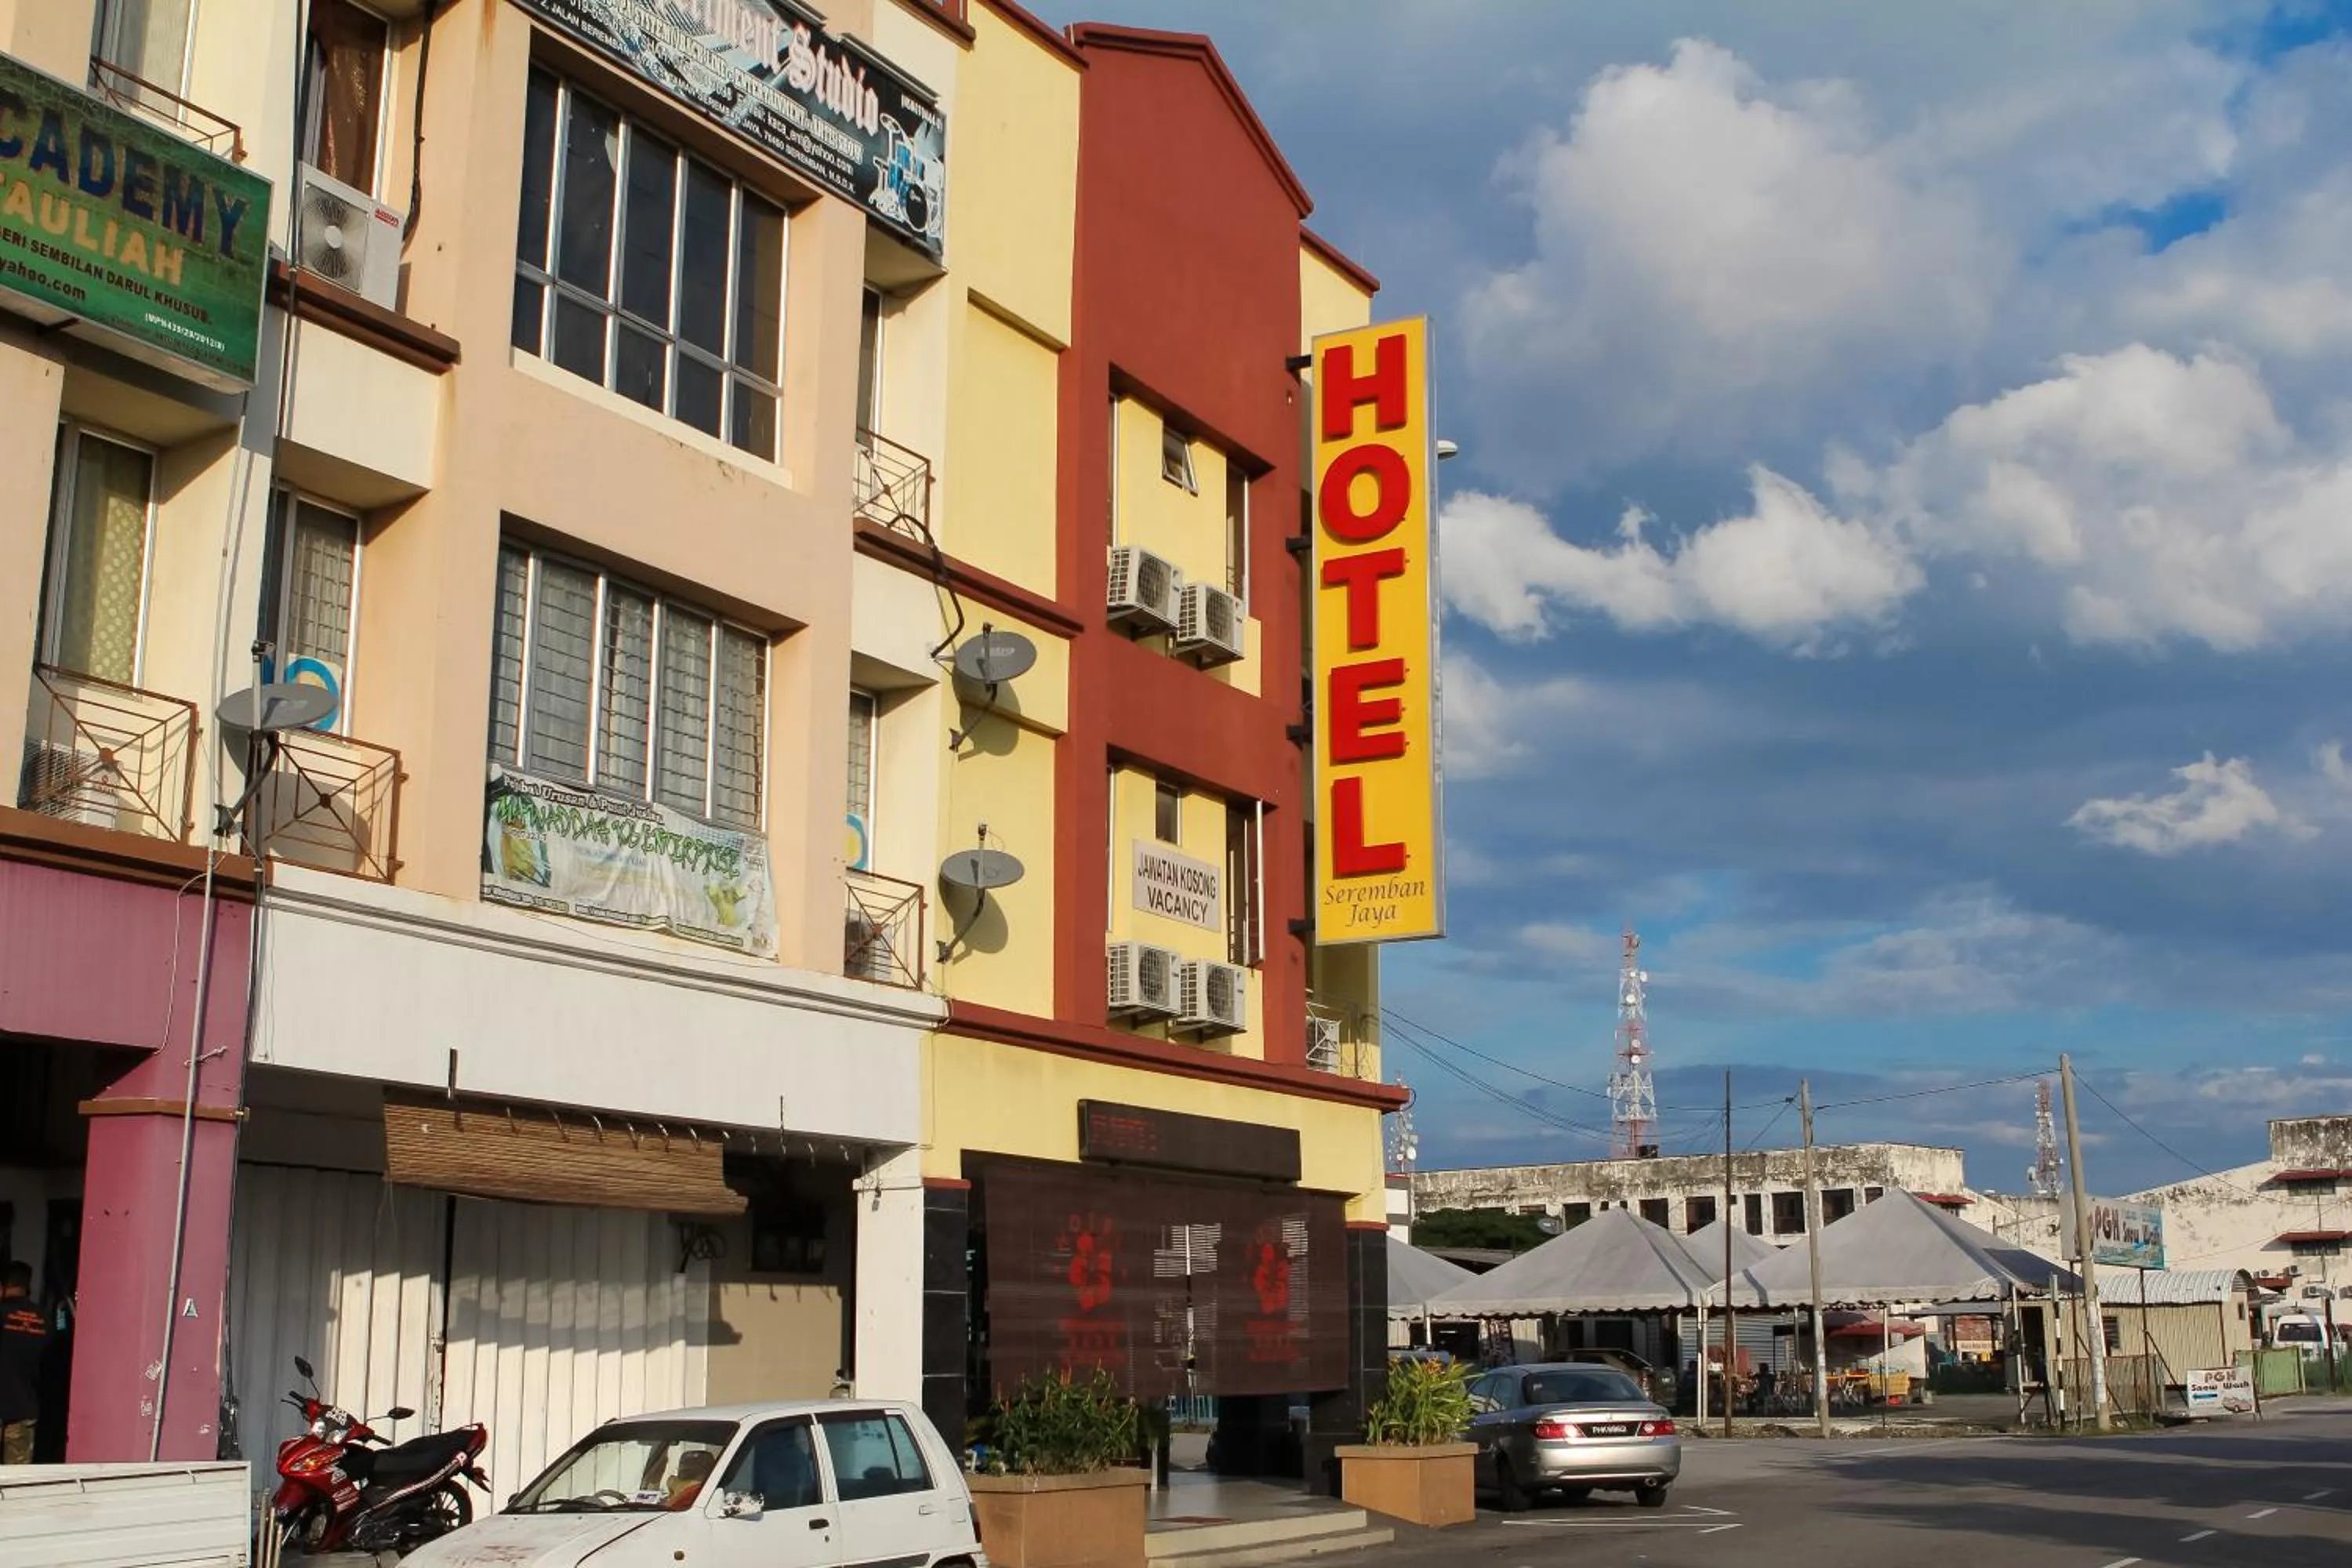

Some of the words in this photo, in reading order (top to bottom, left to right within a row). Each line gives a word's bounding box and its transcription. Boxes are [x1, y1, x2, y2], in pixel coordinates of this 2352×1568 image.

[550, 4, 579, 27] JALAN
[734, 67, 808, 130] ENTERTAINMENT
[787, 21, 880, 137] Studio
[0, 87, 249, 260] CADEMY
[0, 173, 184, 287] AULIAH
[0, 226, 27, 249] ERI
[30, 238, 103, 280] SEMBILAN
[106, 270, 151, 300] DARUL
[1318, 333, 1411, 879] HOTEL
[542, 785, 587, 808] Urusan
[1138, 852, 1178, 887] JAWATAN
[1180, 865, 1216, 899] KOSONG
[1323, 875, 1425, 906] Seremban
[1147, 885, 1208, 924] VACANCY
[1345, 903, 1396, 929] Jaya
[2204, 1370, 2237, 1383] PGH
